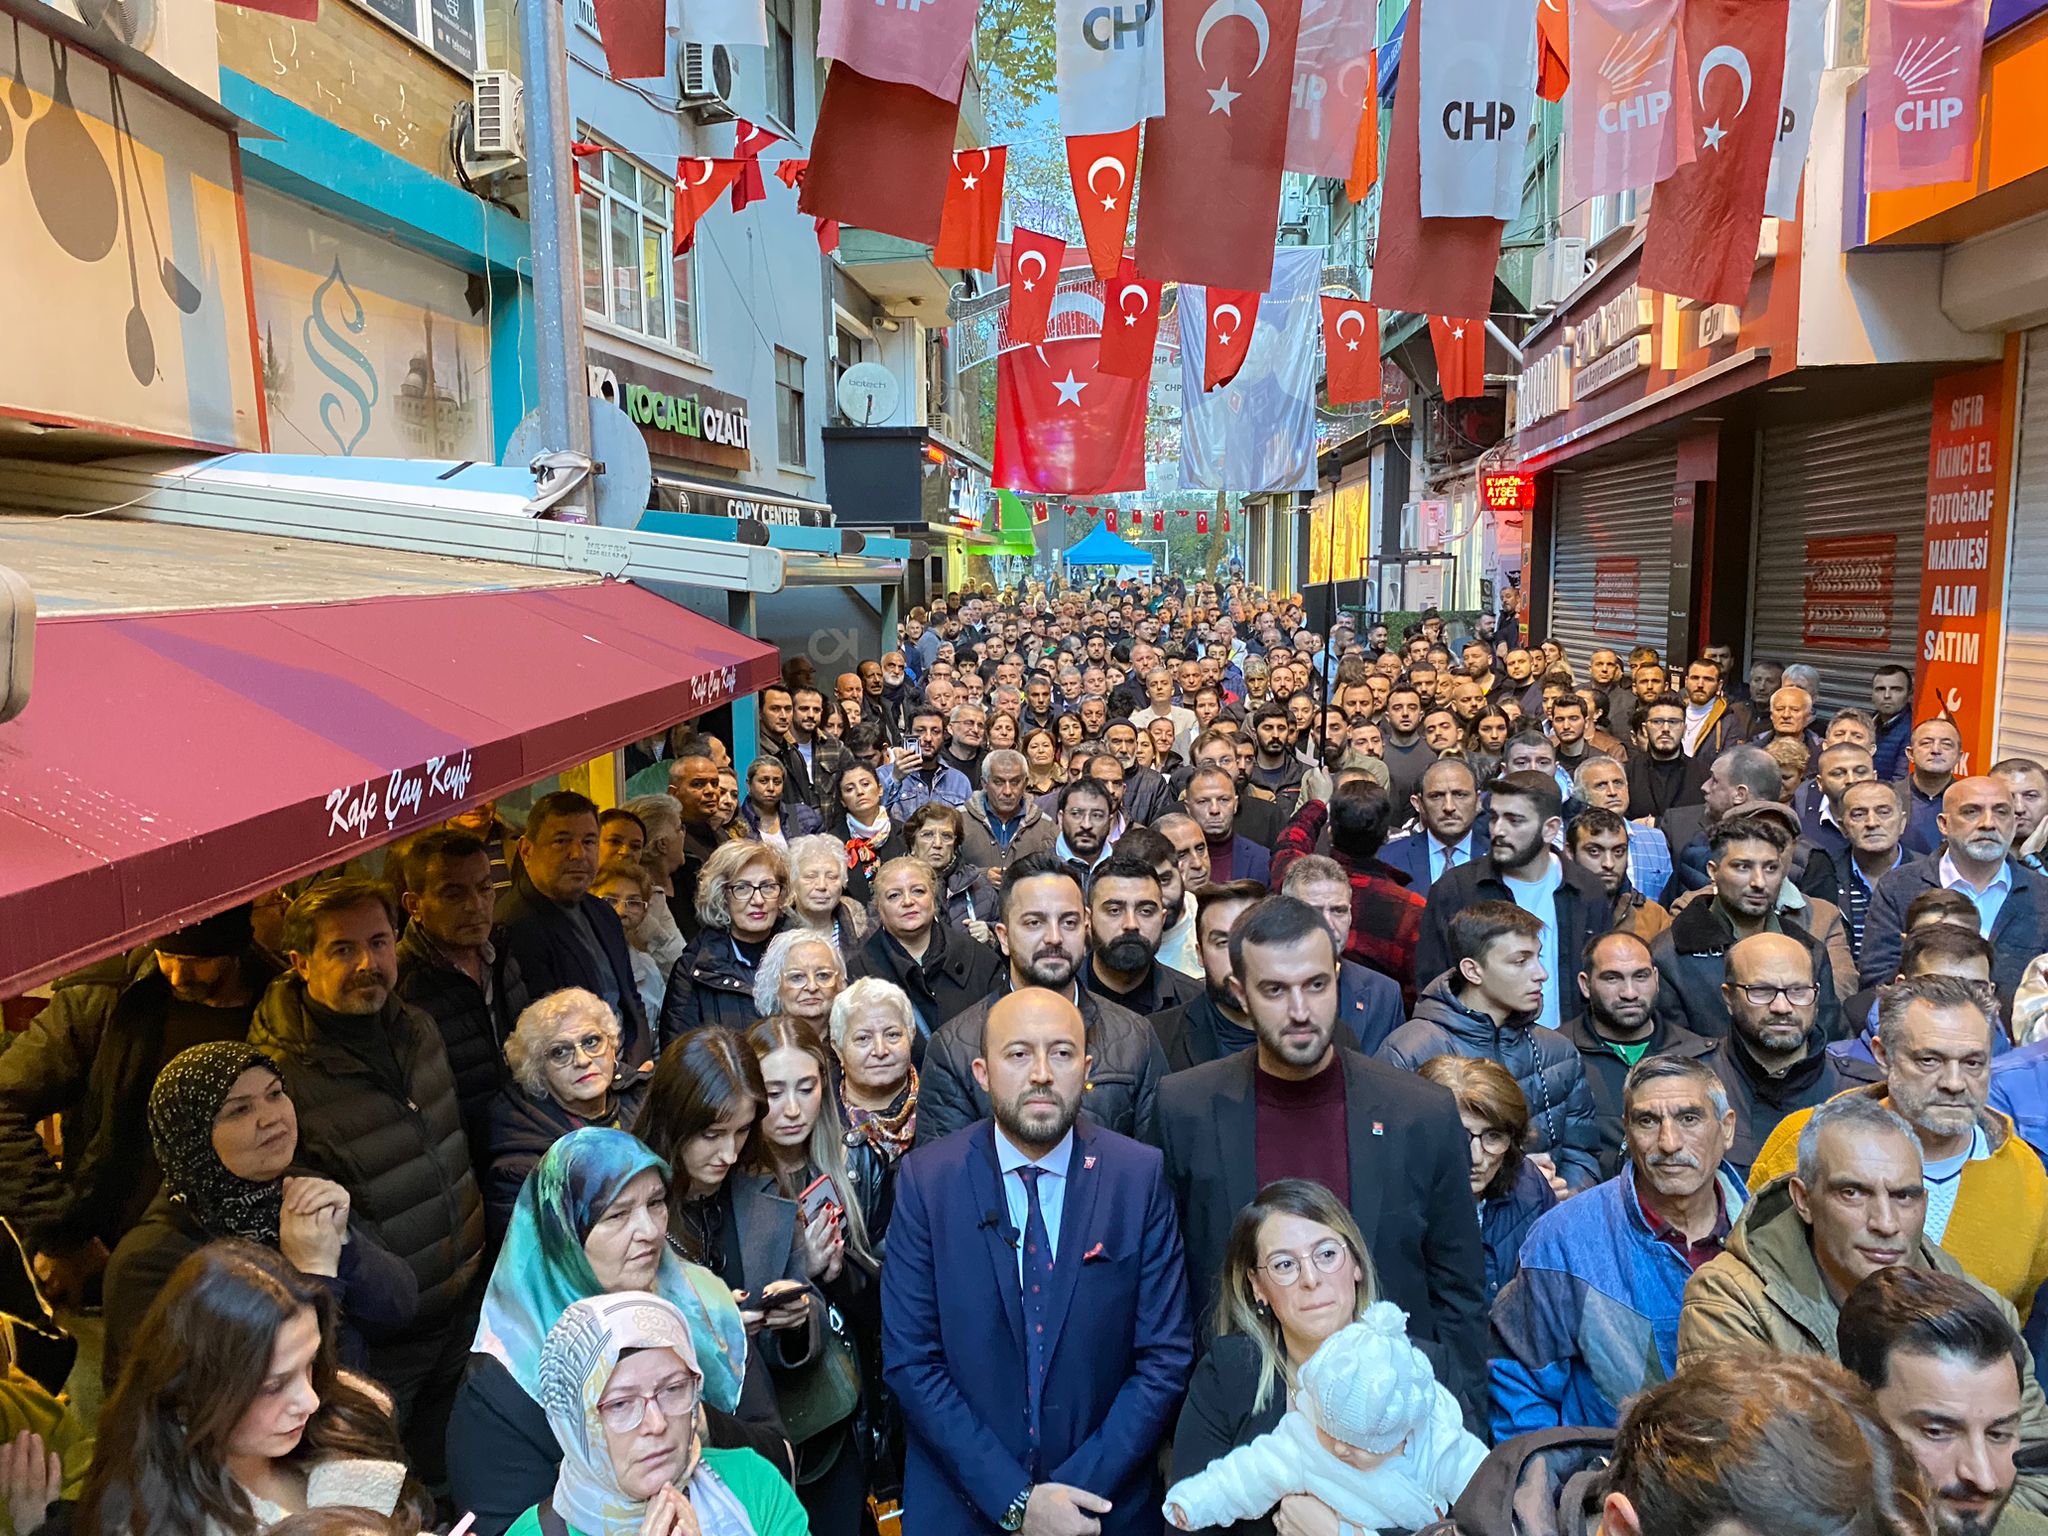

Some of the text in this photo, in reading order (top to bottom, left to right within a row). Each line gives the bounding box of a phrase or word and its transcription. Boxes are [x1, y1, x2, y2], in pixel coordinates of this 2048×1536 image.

[1442, 101, 1516, 141] CHP
[1599, 91, 1672, 134] CHP
[1895, 97, 1963, 132] CHP
[626, 383, 701, 438] KOCAELİ
[701, 405, 751, 449] OZALİT
[1950, 394, 1985, 431] SIFIR
[1976, 440, 1993, 474] EL
[1487, 487, 1519, 498] AYSEL
[1928, 483, 1994, 526] FOTOĞRAF
[727, 499, 800, 527] COPY CENTER
[1927, 529, 1989, 571] MAKİNESİ
[1931, 585, 1977, 617] ALIM
[1924, 630, 1980, 665] SATIM
[325, 748, 473, 838] Kafe Çay Keyfi
